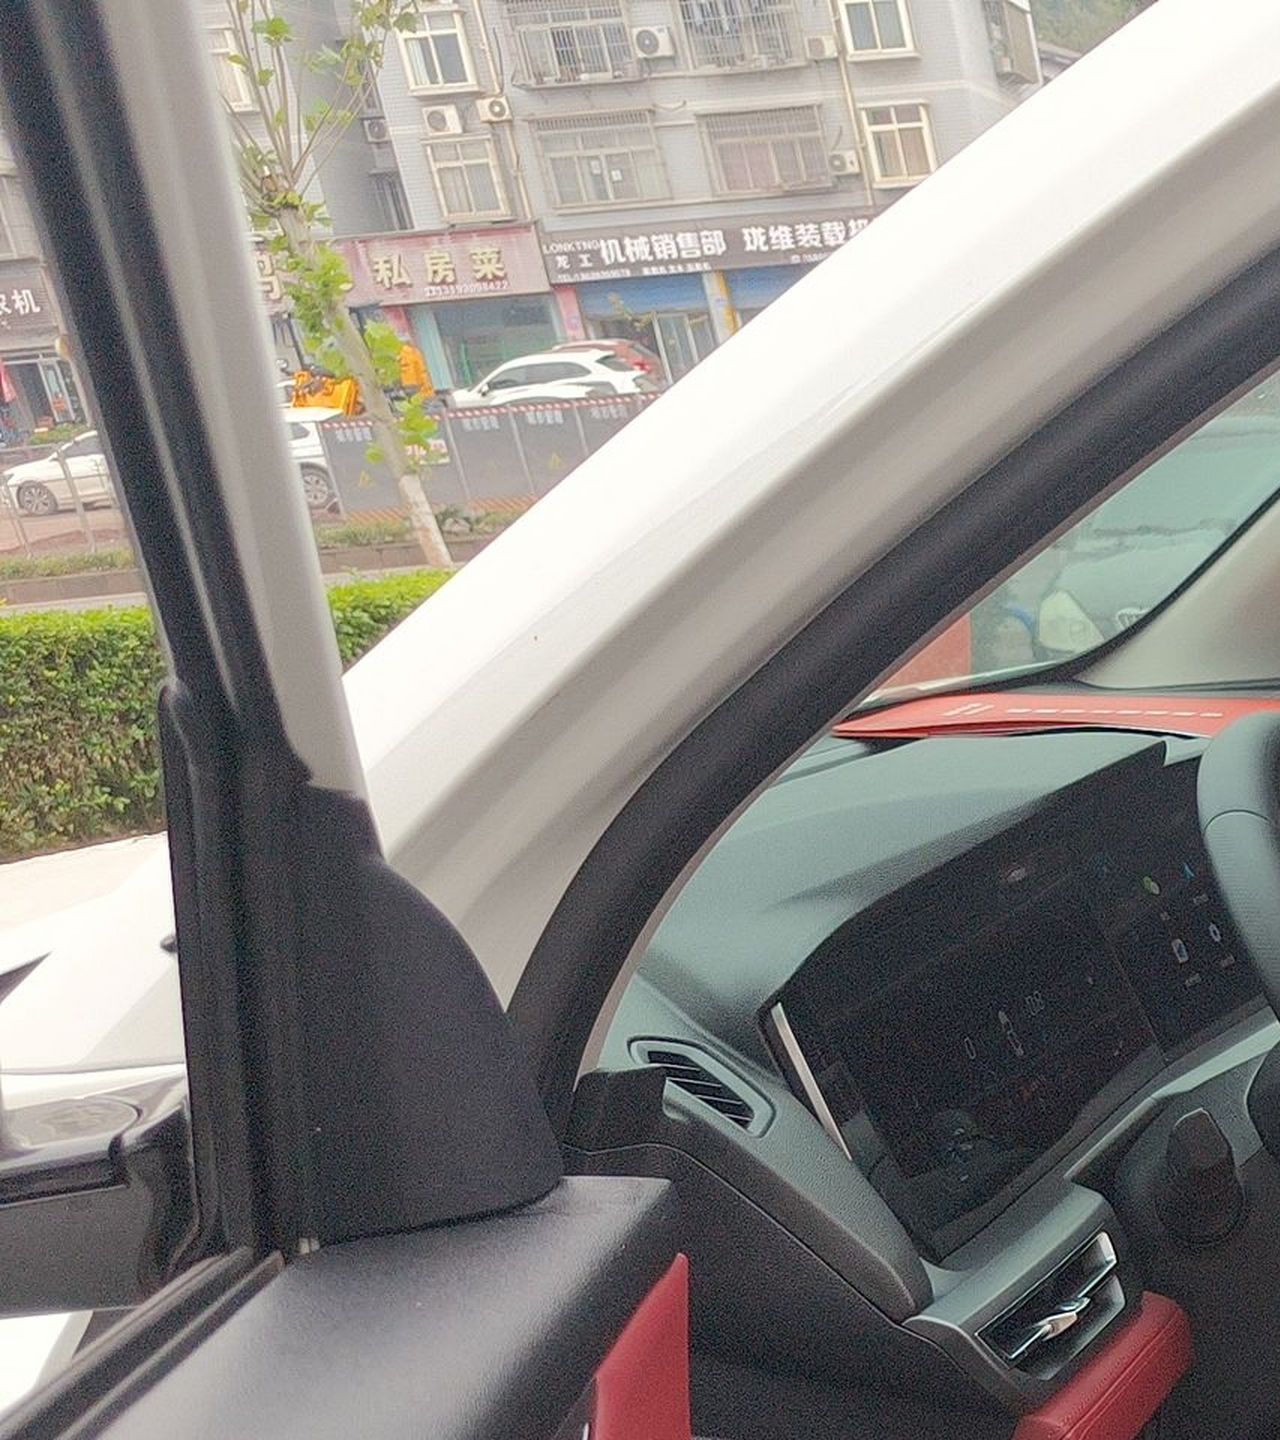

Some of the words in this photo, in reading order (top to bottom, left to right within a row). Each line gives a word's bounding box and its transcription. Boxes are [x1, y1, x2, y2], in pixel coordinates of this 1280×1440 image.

[601, 230, 727, 265] 机械销售部
[373, 246, 506, 290] 私房菜
